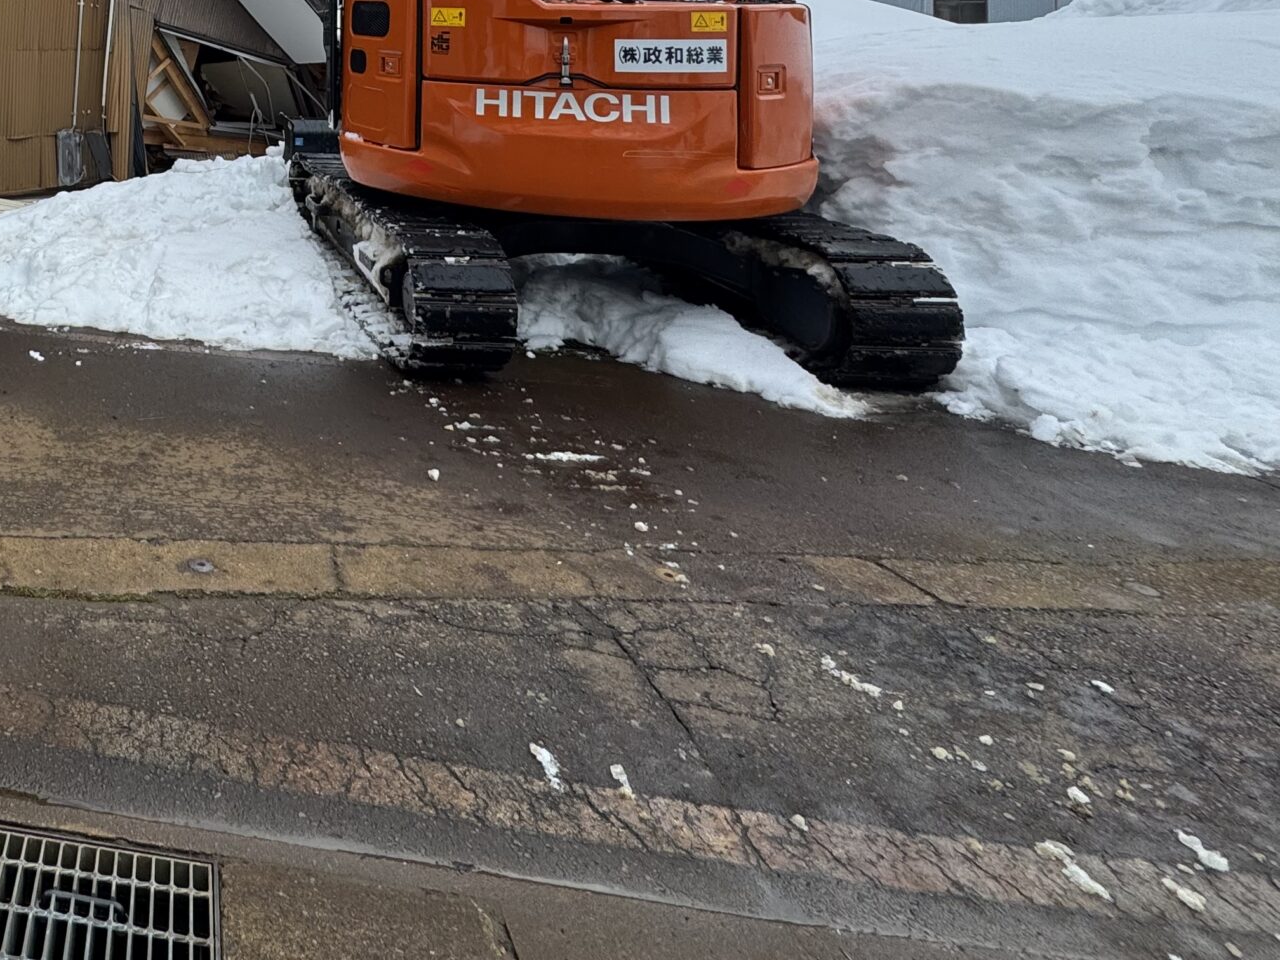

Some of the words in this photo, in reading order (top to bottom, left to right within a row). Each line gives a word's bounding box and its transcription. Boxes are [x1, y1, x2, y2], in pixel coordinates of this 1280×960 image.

[618, 45, 724, 65] (株)政和総業
[475, 88, 670, 125] HITACHI
